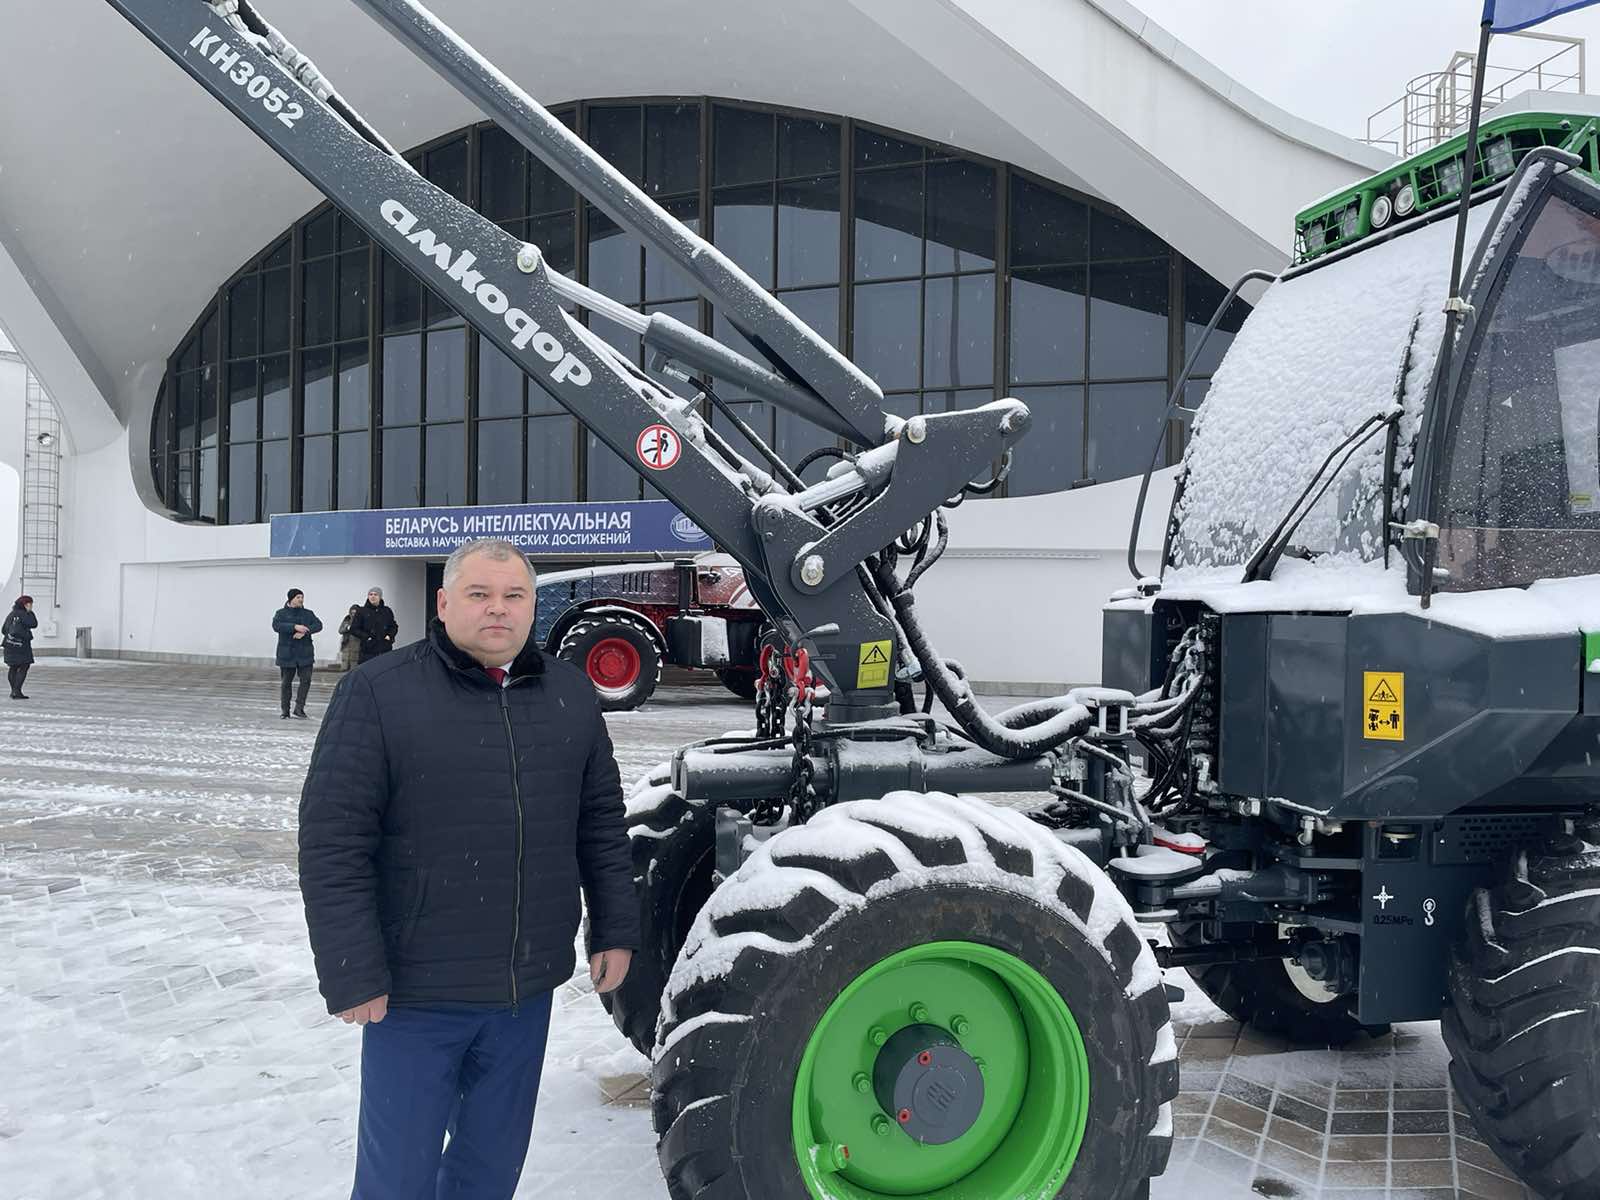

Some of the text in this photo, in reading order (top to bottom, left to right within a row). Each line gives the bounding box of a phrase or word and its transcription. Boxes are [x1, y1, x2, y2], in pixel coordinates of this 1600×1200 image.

[385, 511, 631, 534] БЕЛАРУСЬ ИНТЕЛЛЕКТУАЛЬНАЯ
[385, 536, 430, 548] ВЫСТАВКА
[551, 530, 631, 546] ДОСТИЖЕНИЙ
